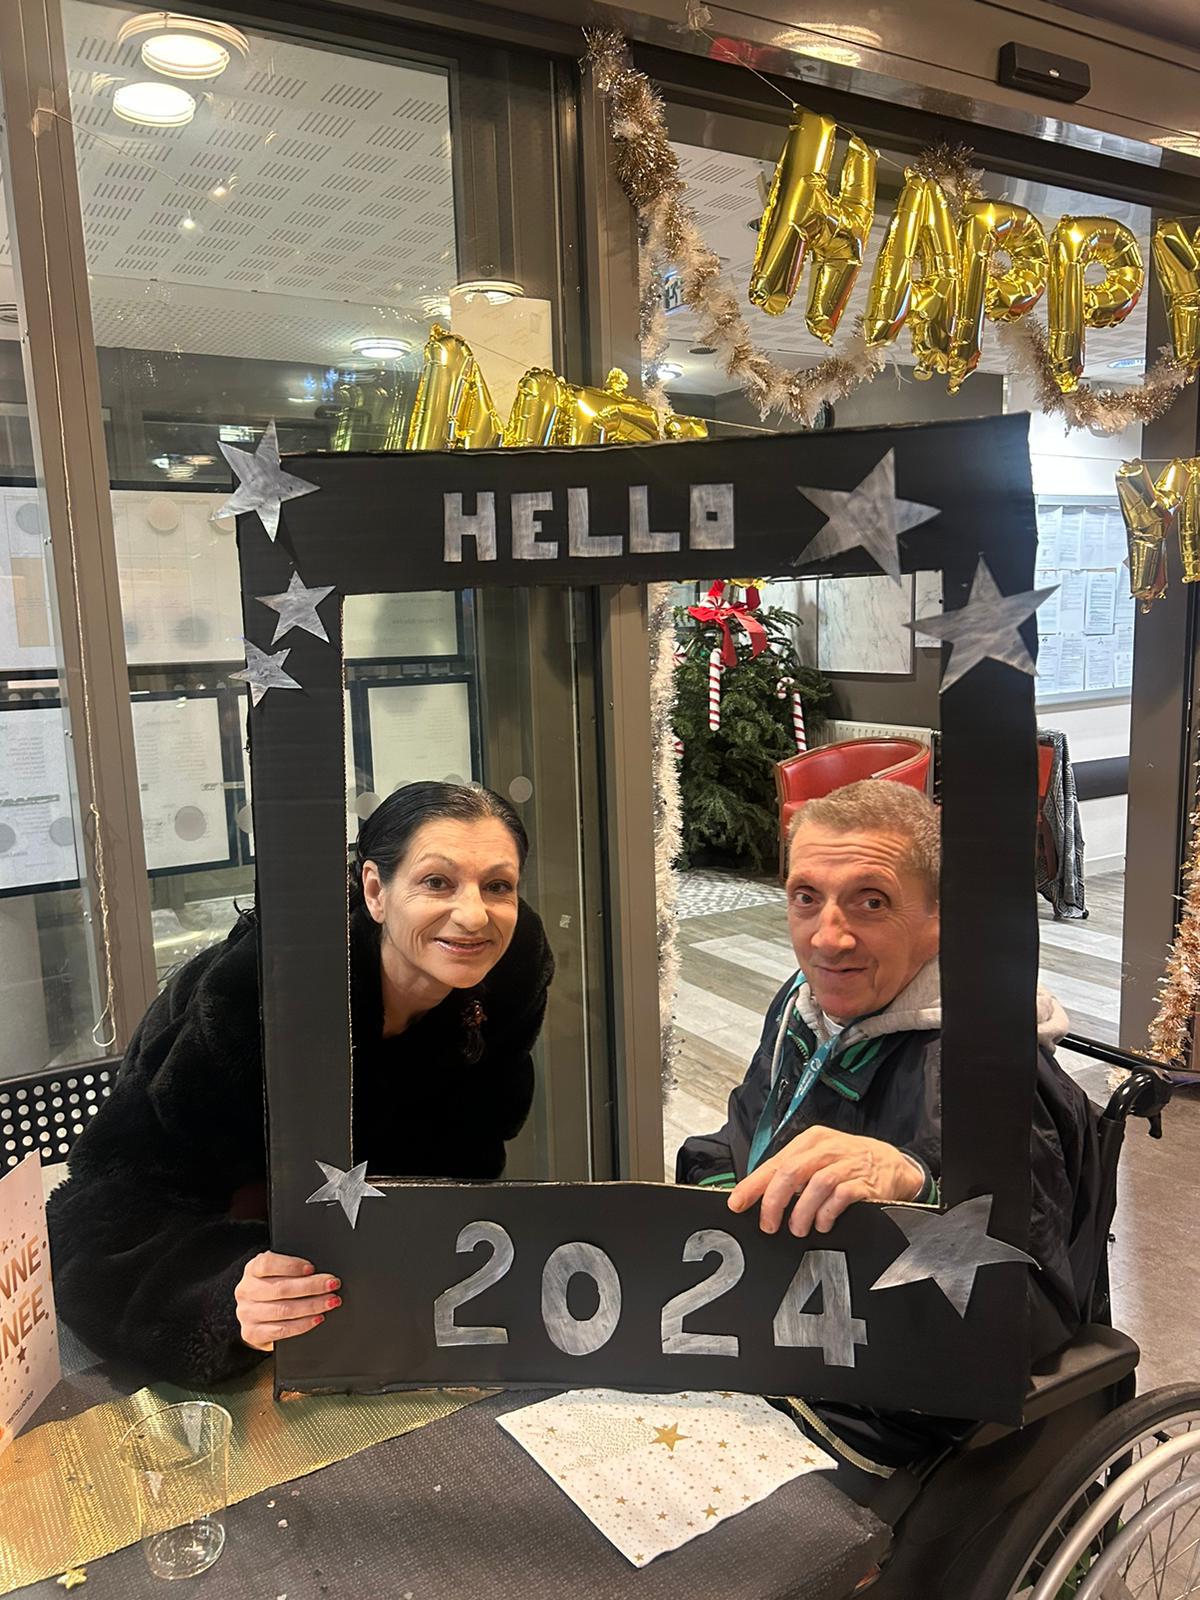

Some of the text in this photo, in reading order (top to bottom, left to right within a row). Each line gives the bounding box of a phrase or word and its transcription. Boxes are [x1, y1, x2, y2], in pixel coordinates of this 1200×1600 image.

[443, 483, 735, 562] HELLO
[0, 1284, 46, 1366] NÉE
[434, 1221, 868, 1368] 2024
